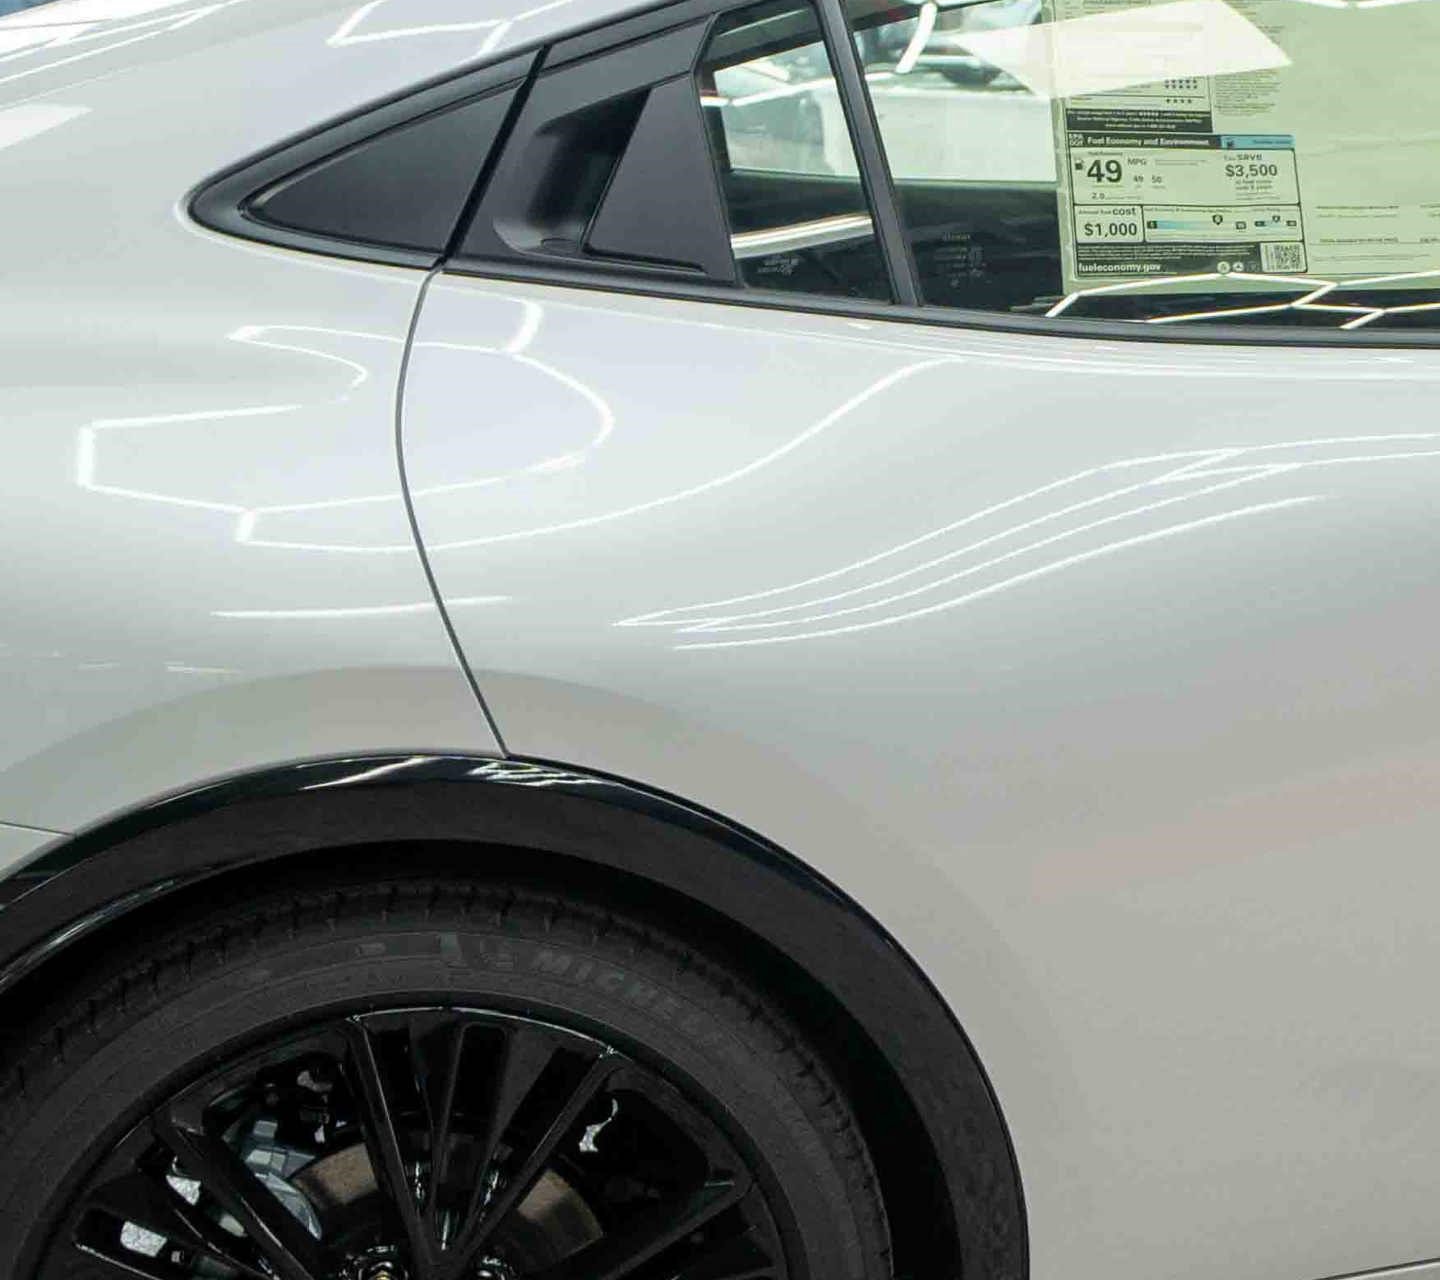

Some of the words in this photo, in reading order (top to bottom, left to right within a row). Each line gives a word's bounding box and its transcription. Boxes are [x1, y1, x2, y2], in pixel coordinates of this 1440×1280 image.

[1086, 159, 1122, 184] 49
[1224, 163, 1278, 179] $3,500
[1084, 221, 1138, 238] $1,000
[1077, 263, 1161, 274] fueleconomy.gov
